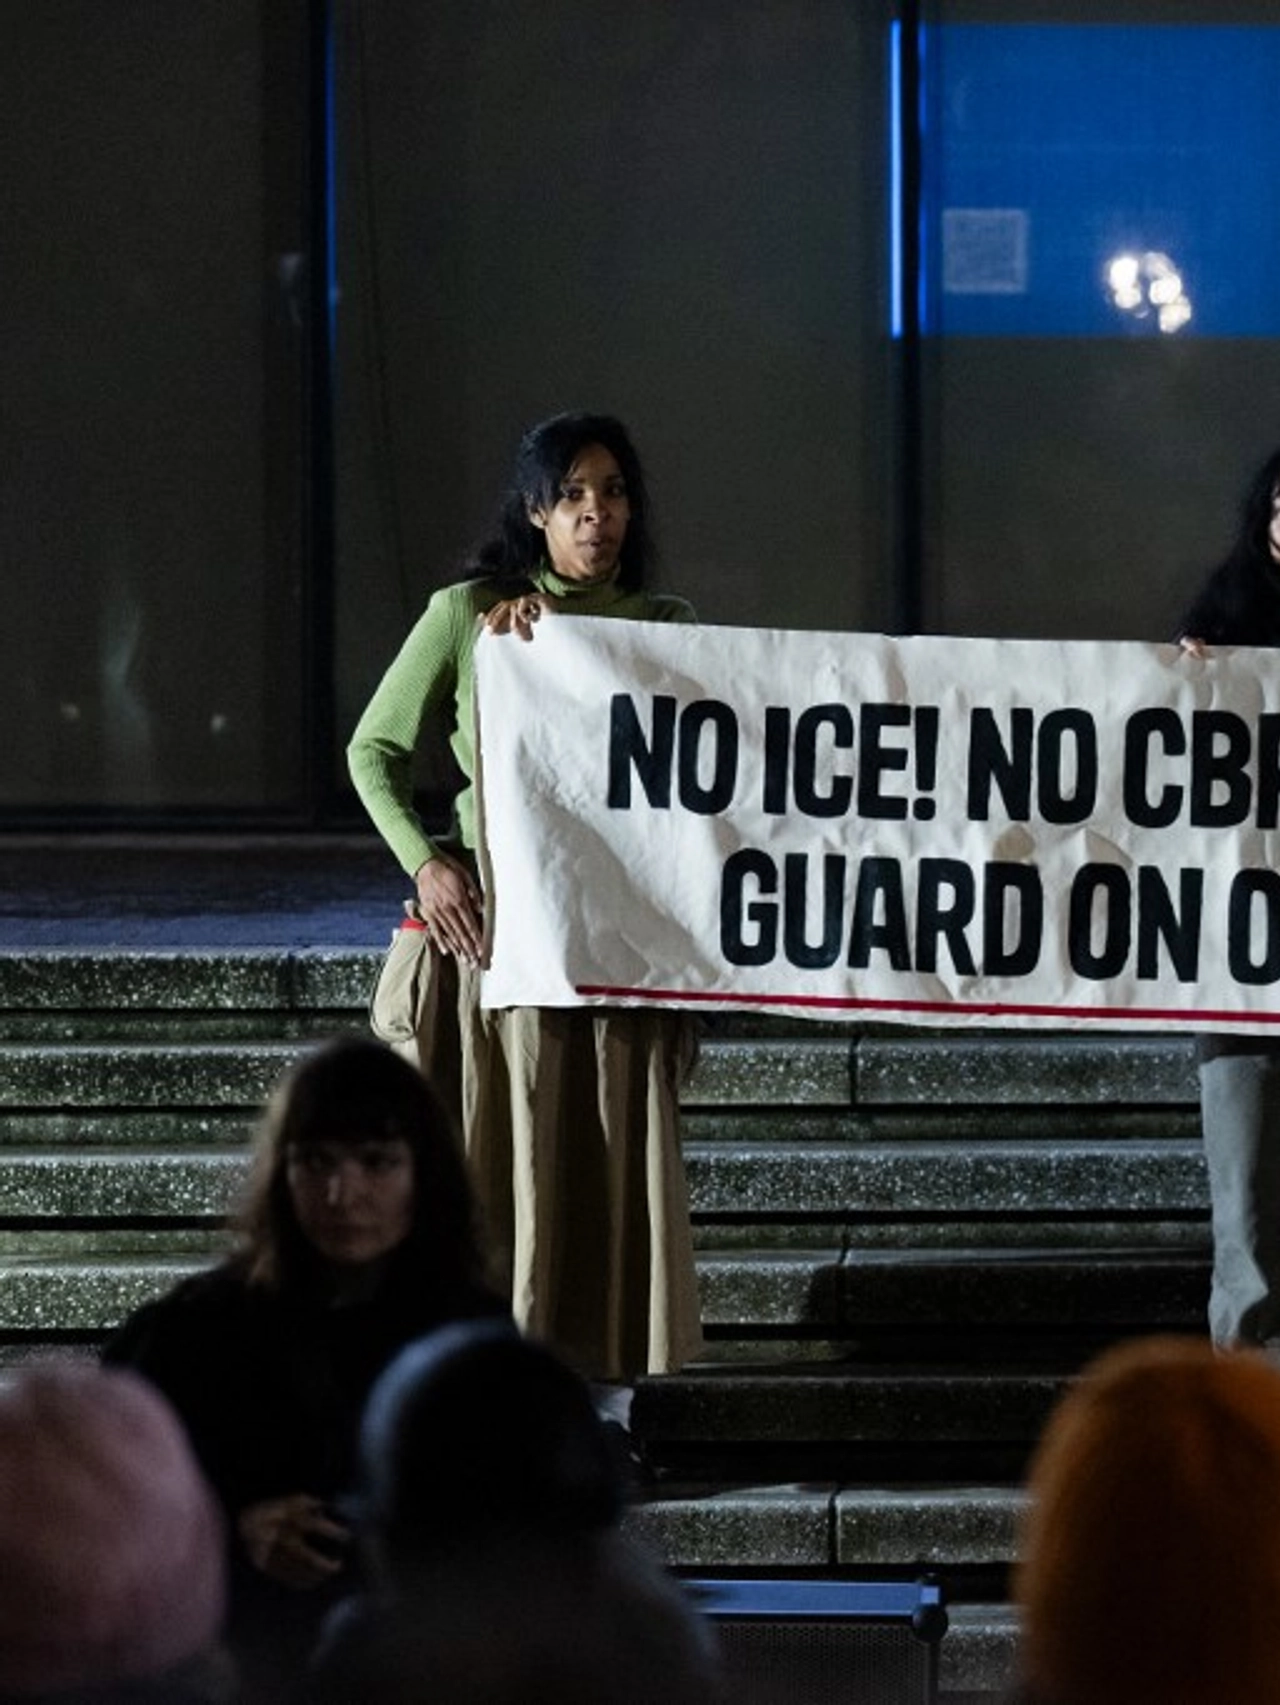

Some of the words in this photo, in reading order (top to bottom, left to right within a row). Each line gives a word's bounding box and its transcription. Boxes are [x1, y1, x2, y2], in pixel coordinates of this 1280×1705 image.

[608, 694, 739, 815] NO
[763, 703, 940, 821] ICE!
[967, 707, 1098, 825] NO
[720, 848, 1044, 977] GUARD
[1068, 862, 1204, 983] ON
